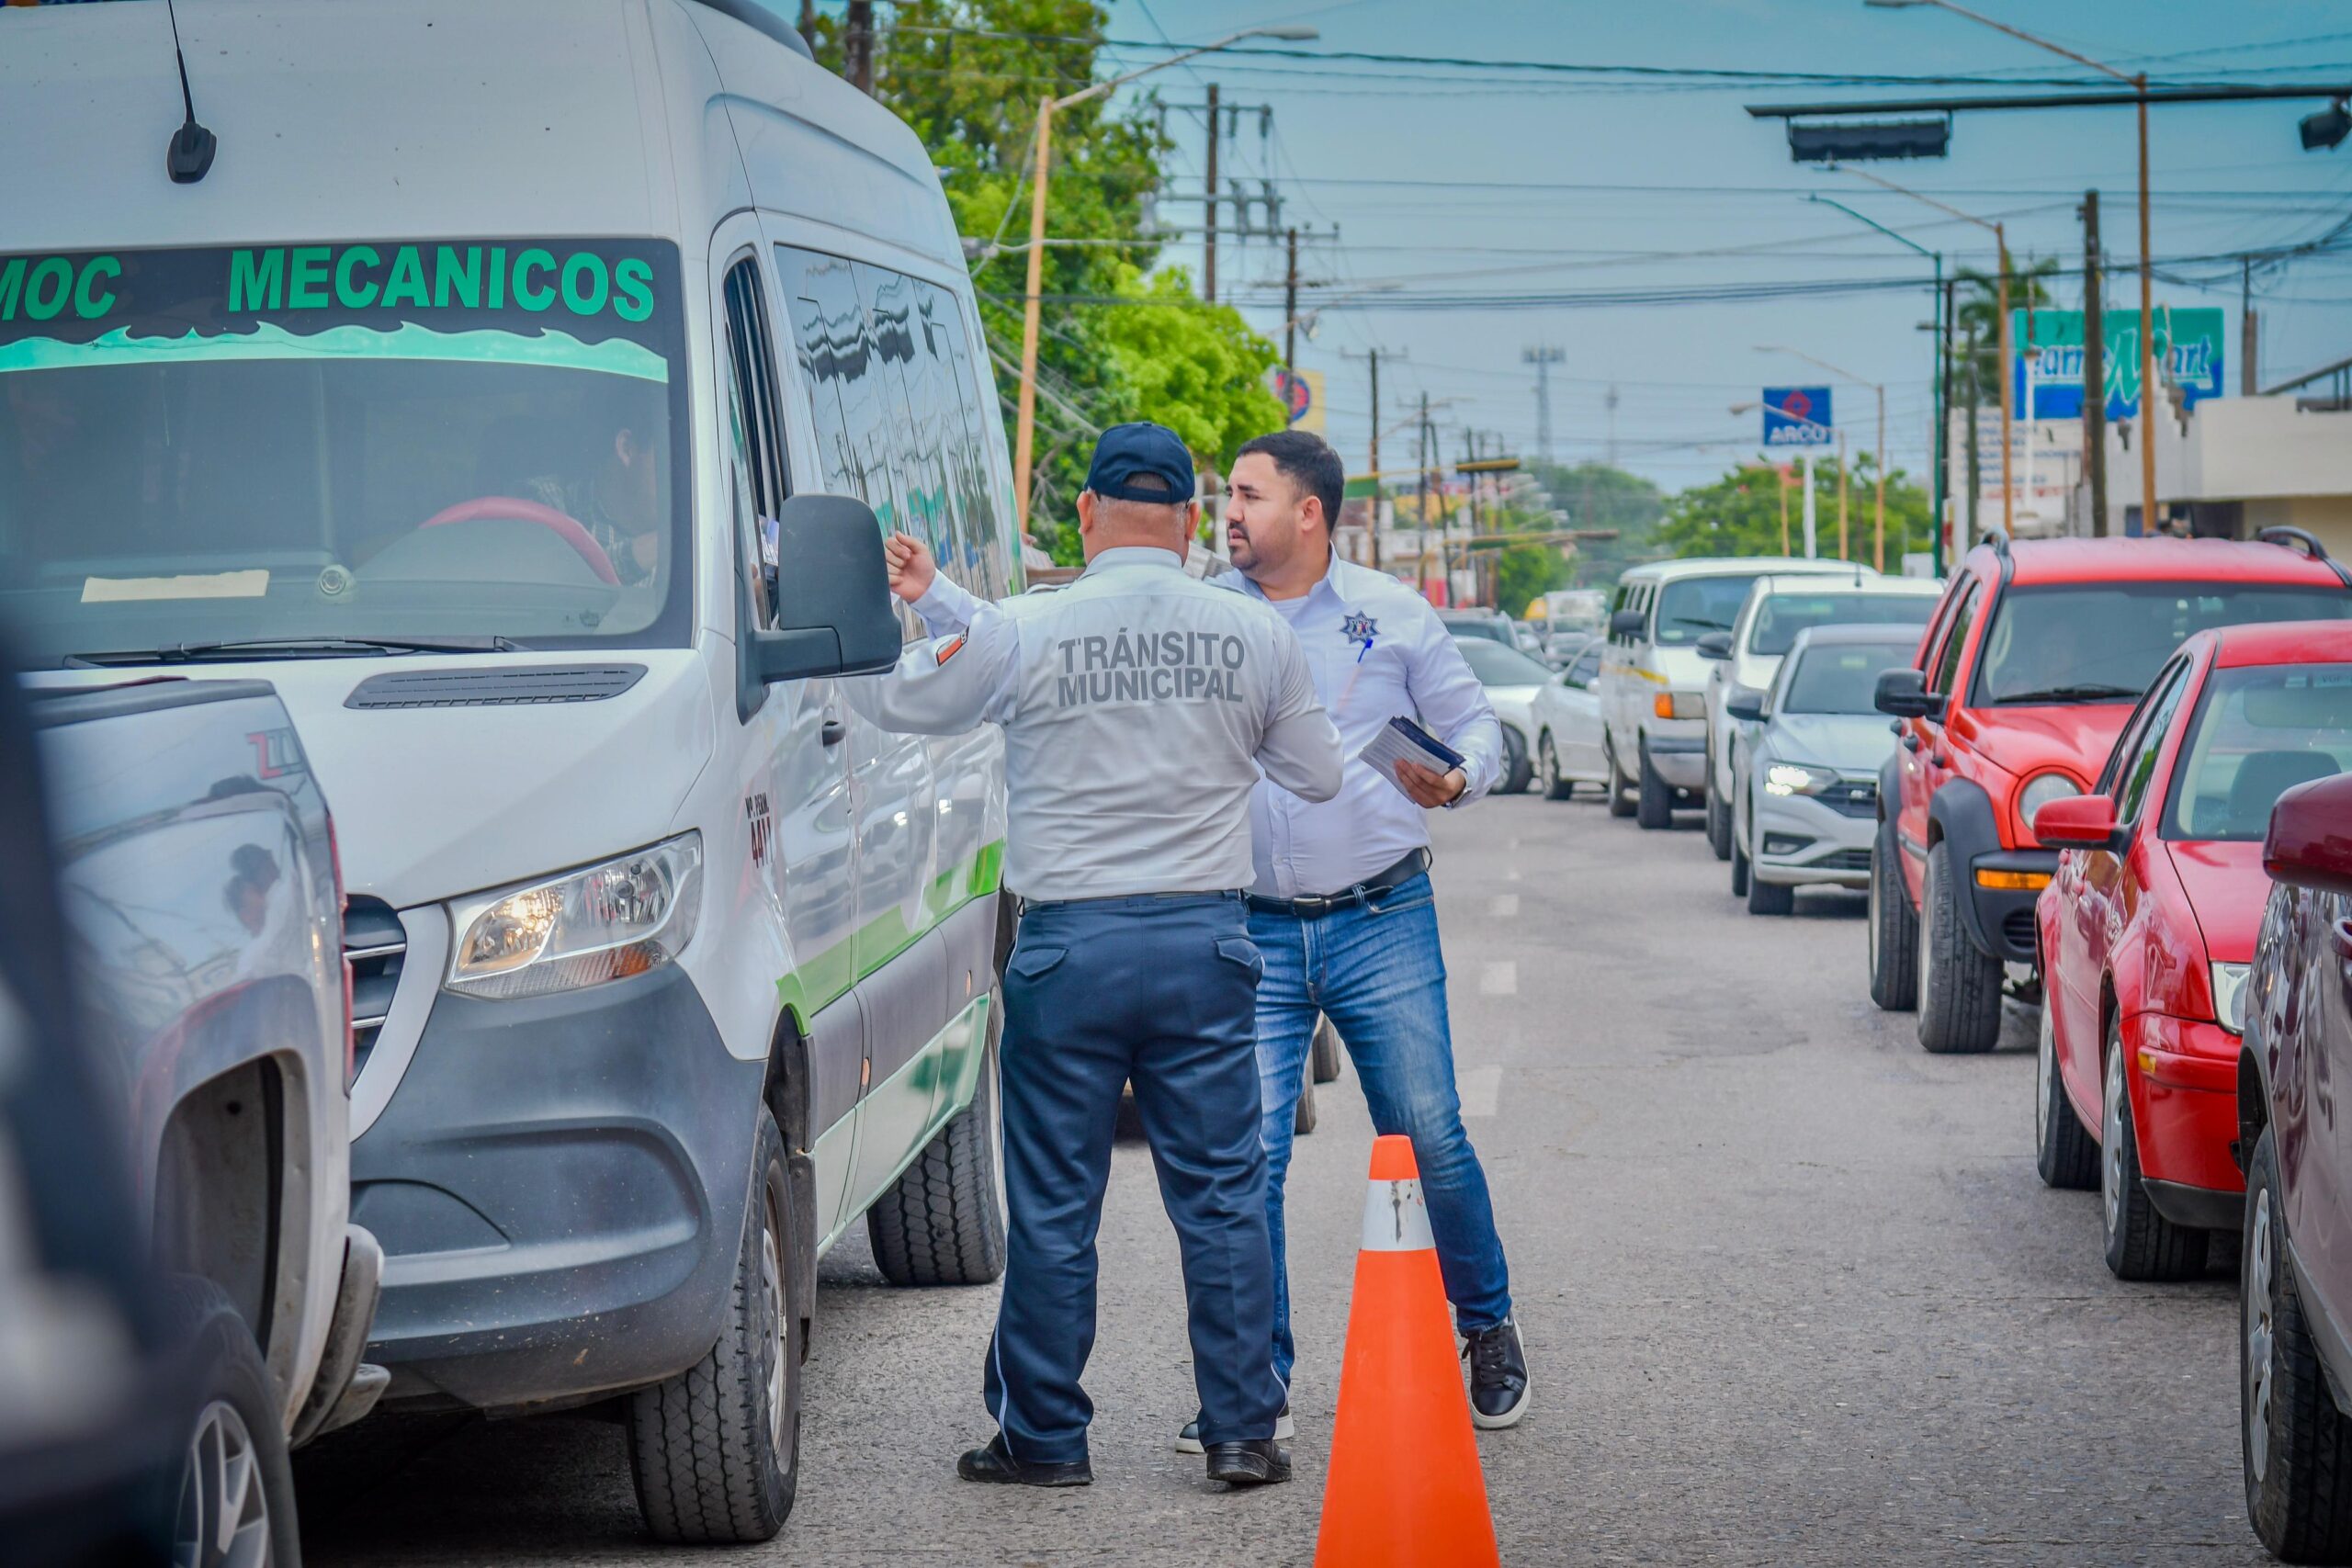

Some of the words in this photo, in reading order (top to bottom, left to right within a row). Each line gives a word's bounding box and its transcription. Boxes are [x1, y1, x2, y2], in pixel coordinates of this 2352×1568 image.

[228, 245, 654, 321] MECANICOS
[1057, 627, 1245, 673] TRÁNSITO
[1057, 668, 1243, 707] MUNICIPAL
[751, 817, 774, 869] 4411
